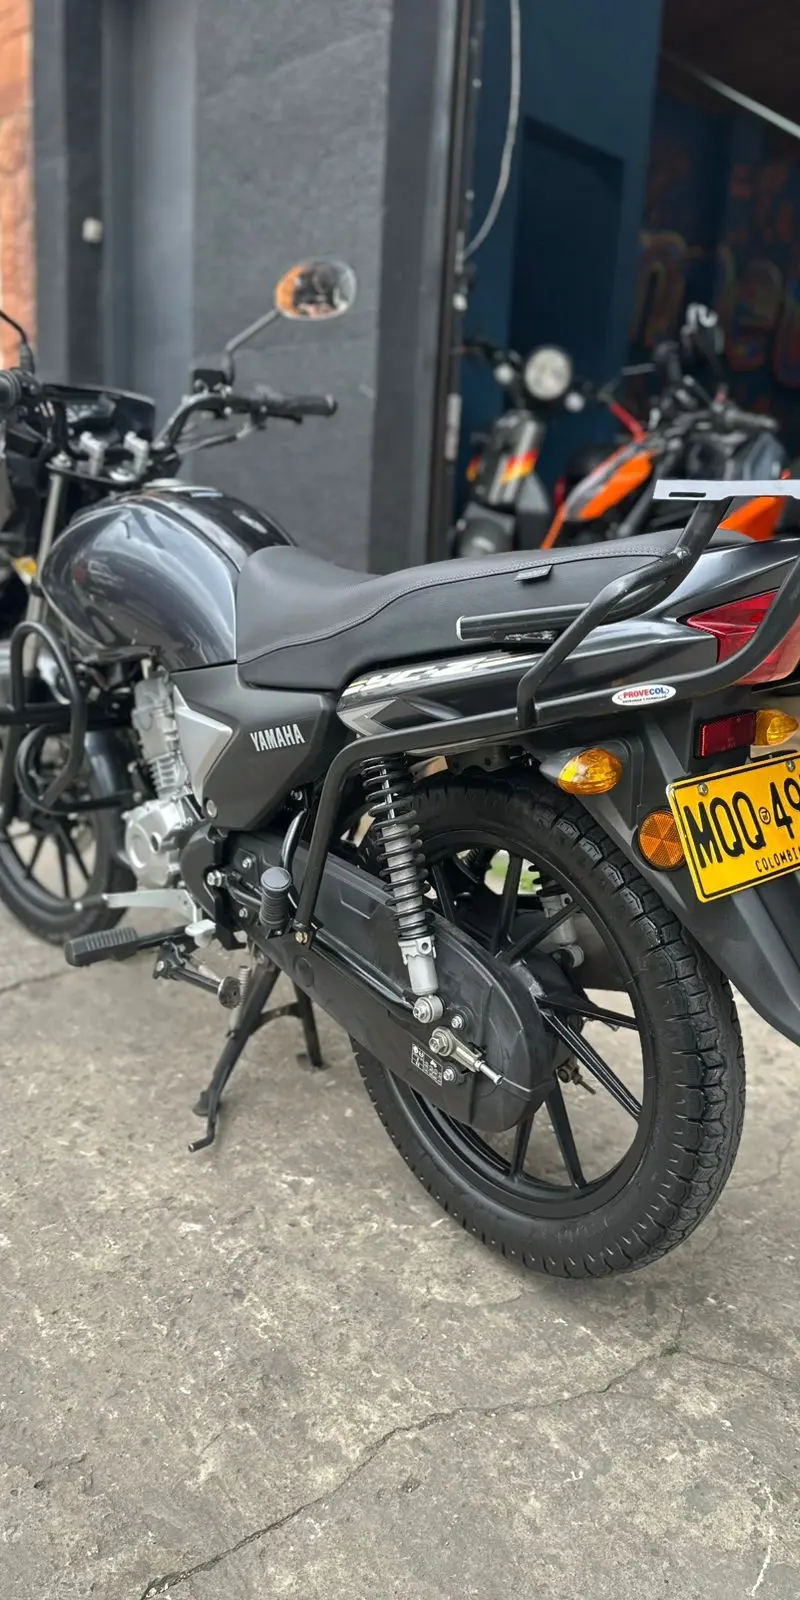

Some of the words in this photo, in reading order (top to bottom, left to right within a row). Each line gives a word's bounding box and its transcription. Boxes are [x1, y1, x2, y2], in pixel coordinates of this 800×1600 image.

[622, 687, 666, 699] PROVECOL
[249, 723, 306, 752] YAMAHA
[683, 791, 767, 869] MQQ
[755, 846, 800, 873] COLOMBI
